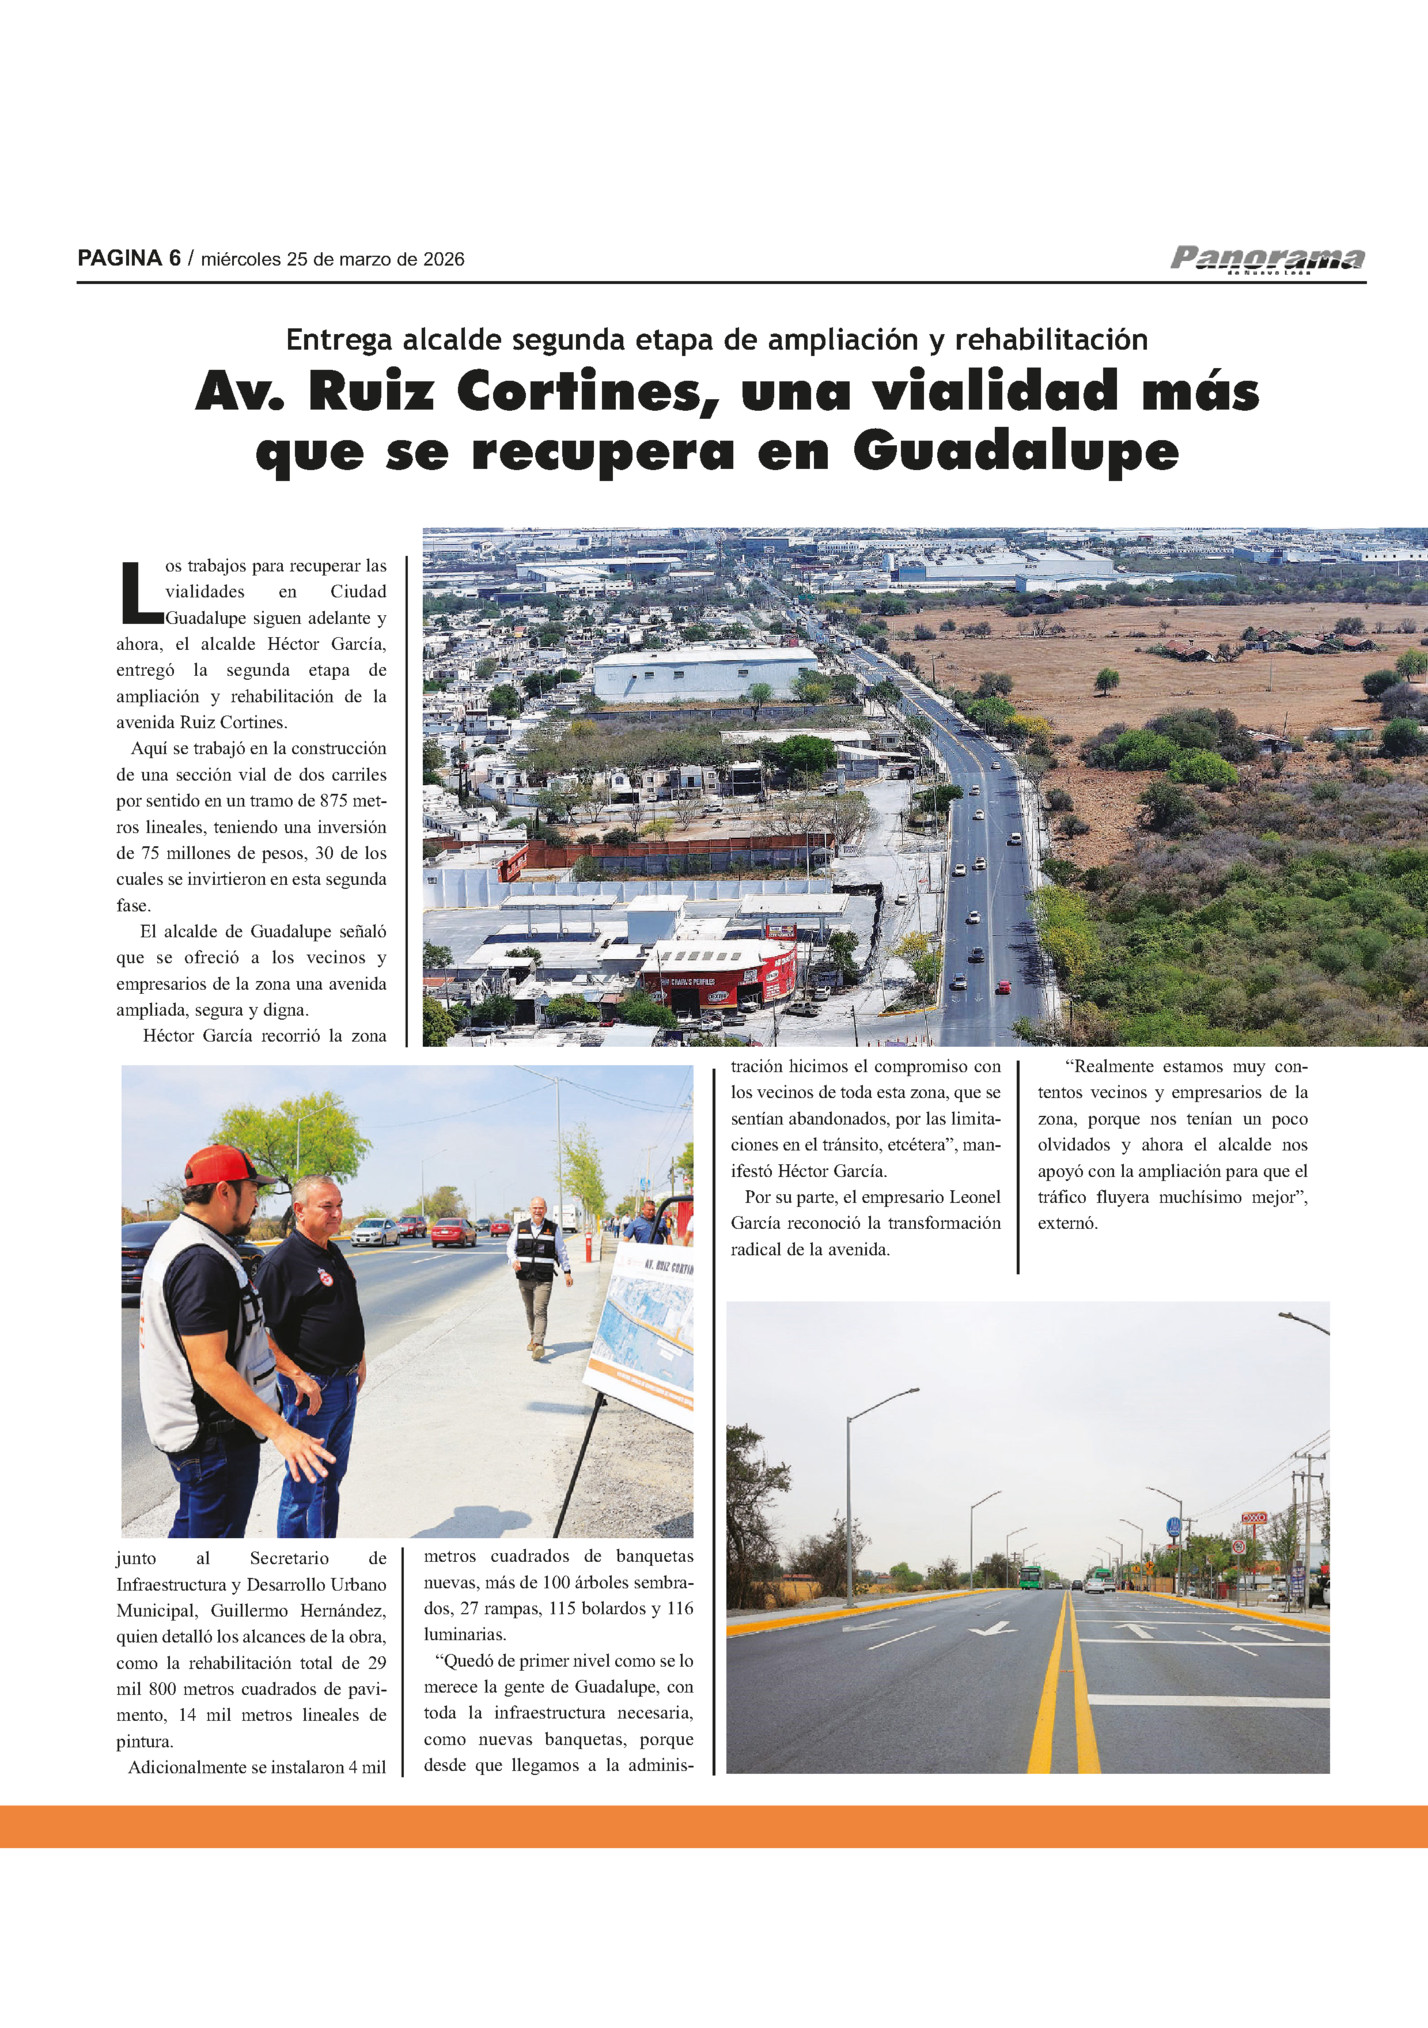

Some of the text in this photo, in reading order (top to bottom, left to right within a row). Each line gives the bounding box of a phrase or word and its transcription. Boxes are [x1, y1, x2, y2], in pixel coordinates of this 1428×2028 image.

[79, 248, 162, 266] PAGINA
[170, 248, 180, 266] 6
[202, 251, 281, 266] miércoles
[288, 251, 307, 266] 25
[314, 251, 334, 266] de
[340, 255, 391, 266] marzo
[397, 251, 417, 266] de
[424, 251, 464, 266] 2026
[1170, 245, 1366, 270] Panorama
[288, 327, 1147, 356] Entrega alcalde segunda etapa de ampliación y rehabilitación
[195, 366, 1259, 419] Av. Ruiz Cortines, una vialidad más
[256, 427, 1179, 481] que se recupera en Guadalupe
[188, 557, 246, 576] trabajos
[253, 562, 284, 576] para
[290, 562, 361, 576] recuperar
[367, 557, 387, 572] las
[166, 610, 386, 628] Guadalupe siguen adelante y
[117, 636, 386, 653] ahora, el alcalde Héctor García,
[117, 688, 386, 706] ampliación y rehabilitación de la
[117, 714, 287, 728] avenida Ruiz Cortines.
[117, 792, 387, 811] por sentido en un tramo de 875 met-
[141, 923, 386, 941] El alcalde de Guadalupe señaló
[117, 976, 386, 994] empresarios de la zona una avenida
[731, 1058, 1001, 1076] tración hicimos el compromiso con
[1066, 1058, 1308, 1076] “Realmente estamos muy con-
[1039, 1111, 1308, 1129] zona, porque nos tenían un poco
[731, 1136, 1001, 1152] ciones en el tránsito, etcétera”, man-
[746, 1189, 1000, 1207] Por su parte, el empresario Leonel
[1039, 1189, 1307, 1207] tráfico fluyera muchísimo mejor”,
[1038, 1215, 1097, 1229] externó.
[1243, 1513, 1265, 1522] OXXO
[117, 1576, 386, 1595] Infraestructura y Desarrollo Urbano
[425, 1574, 694, 1591] nuevas, más de 100 árboles sembra-
[118, 1602, 386, 1621] Municipal, Guillermo Hernández,
[424, 1600, 693, 1618] dos, 27 rampas, 115 bolardos y 116
[117, 1655, 386, 1669] como la rehabilitación total de 29
[436, 1653, 693, 1671] “Quedó de primer nivel como se lo
[424, 1704, 693, 1720] toda la infraestructura necesaria,
